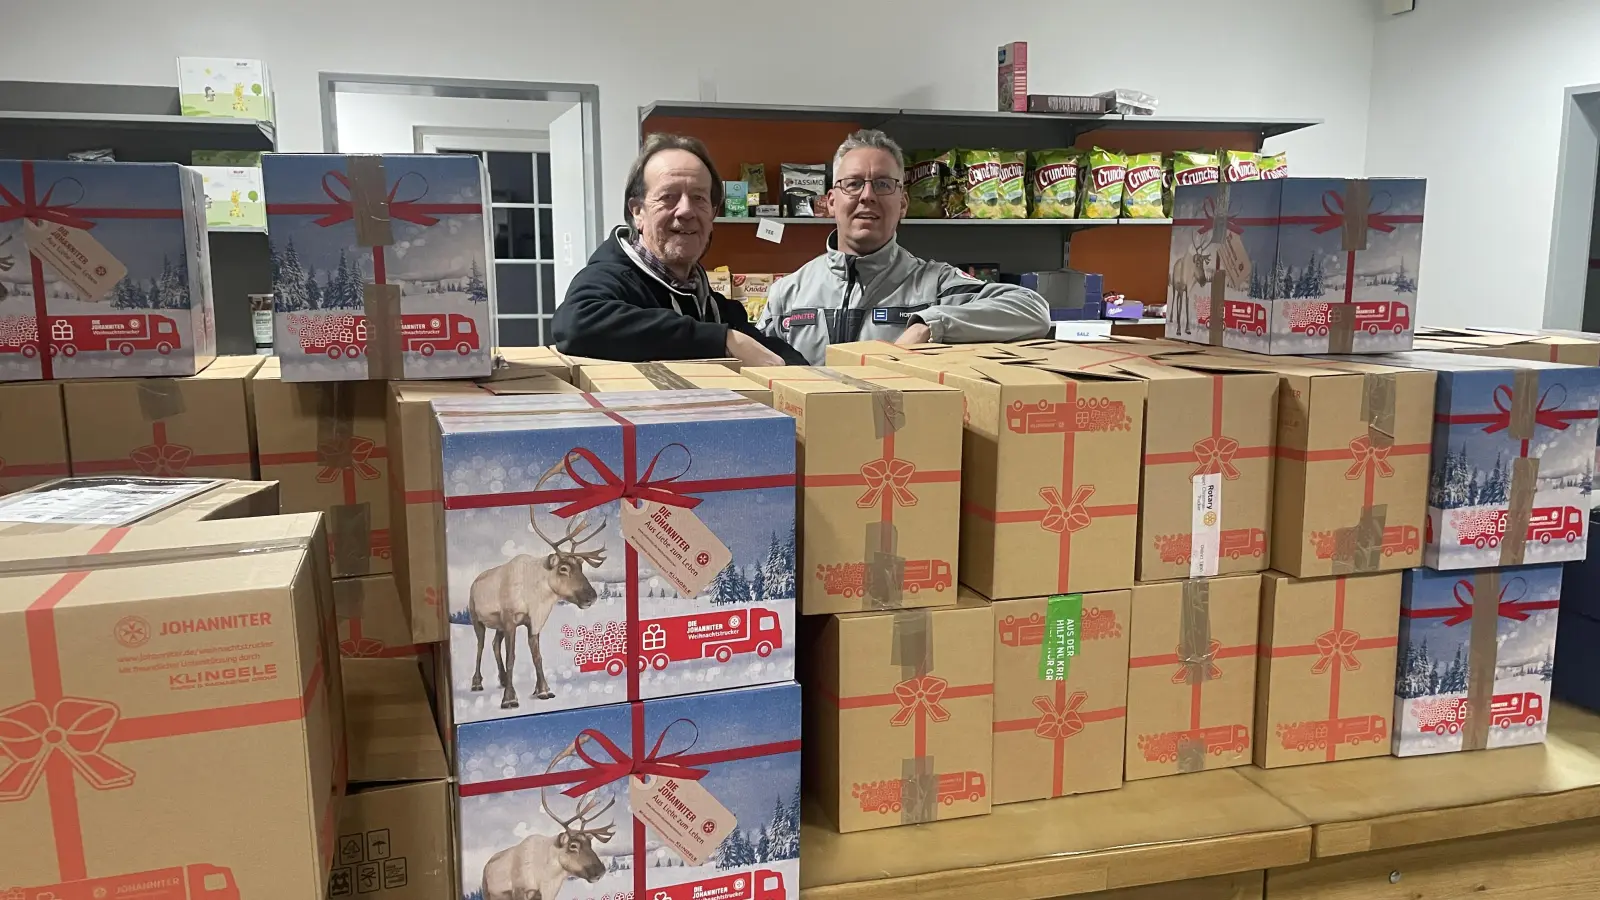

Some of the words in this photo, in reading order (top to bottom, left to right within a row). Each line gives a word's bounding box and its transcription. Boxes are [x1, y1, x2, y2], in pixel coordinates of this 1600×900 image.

[658, 506, 672, 519] DIE
[650, 512, 690, 552] JOHANNITER
[644, 521, 657, 534] Aus
[656, 531, 671, 548] Liebe
[670, 547, 682, 561] zum
[682, 558, 698, 577] Leben
[669, 571, 692, 594] KLINGELE
[159, 612, 272, 636] JOHANNITER
[687, 624, 723, 633] JOHANNITER
[688, 629, 739, 640] Weihnachtstrucker
[1066, 638, 1074, 656] DER
[169, 664, 277, 685] KLINGELE
[1046, 668, 1054, 680] GR
[1056, 660, 1064, 681] KRIS
[665, 779, 678, 792] DIE
[658, 786, 696, 822] JOHANNITER
[651, 795, 664, 807] Aus
[663, 803, 678, 820] Liebe
[677, 819, 689, 831] zum
[688, 828, 704, 845] Leben
[115, 877, 179, 895] JOHANNITER
[693, 887, 728, 899] JOHANNITER
